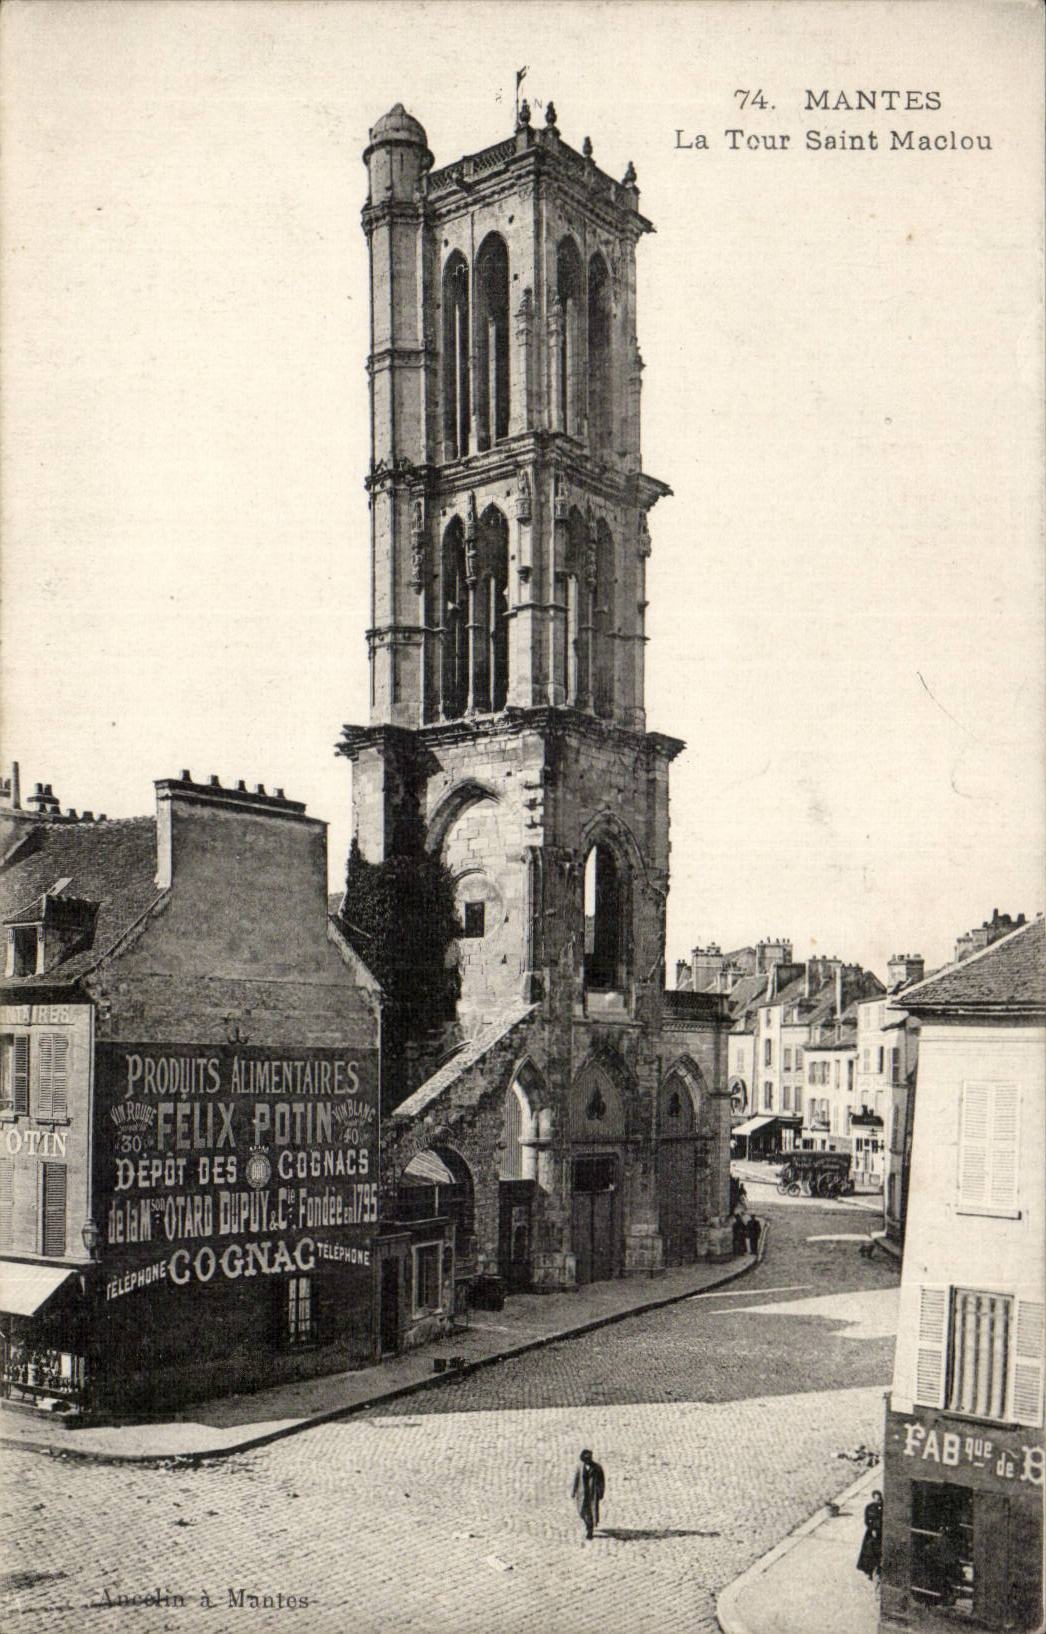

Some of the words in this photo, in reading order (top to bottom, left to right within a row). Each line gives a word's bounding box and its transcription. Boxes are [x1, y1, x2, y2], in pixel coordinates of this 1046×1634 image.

[124, 1054, 221, 1098] PRODUITS
[231, 1056, 359, 1096] ALIMENTAIRES
[121, 1135, 142, 1152] 30
[158, 1094, 236, 1149] FÉLIX
[254, 1102, 333, 1146] POTIN
[114, 1152, 187, 1191] DÉPÔT
[198, 1156, 237, 1185] DES
[278, 1148, 369, 1180] COGNACS
[108, 1200, 124, 1244] de
[126, 1200, 138, 1242] la
[164, 1194, 213, 1242] OTARD
[219, 1190, 270, 1235] DUPUY
[353, 1183, 378, 1224] 1795
[168, 1237, 316, 1285] COGNAC
[996, 1452, 1014, 1478] de
